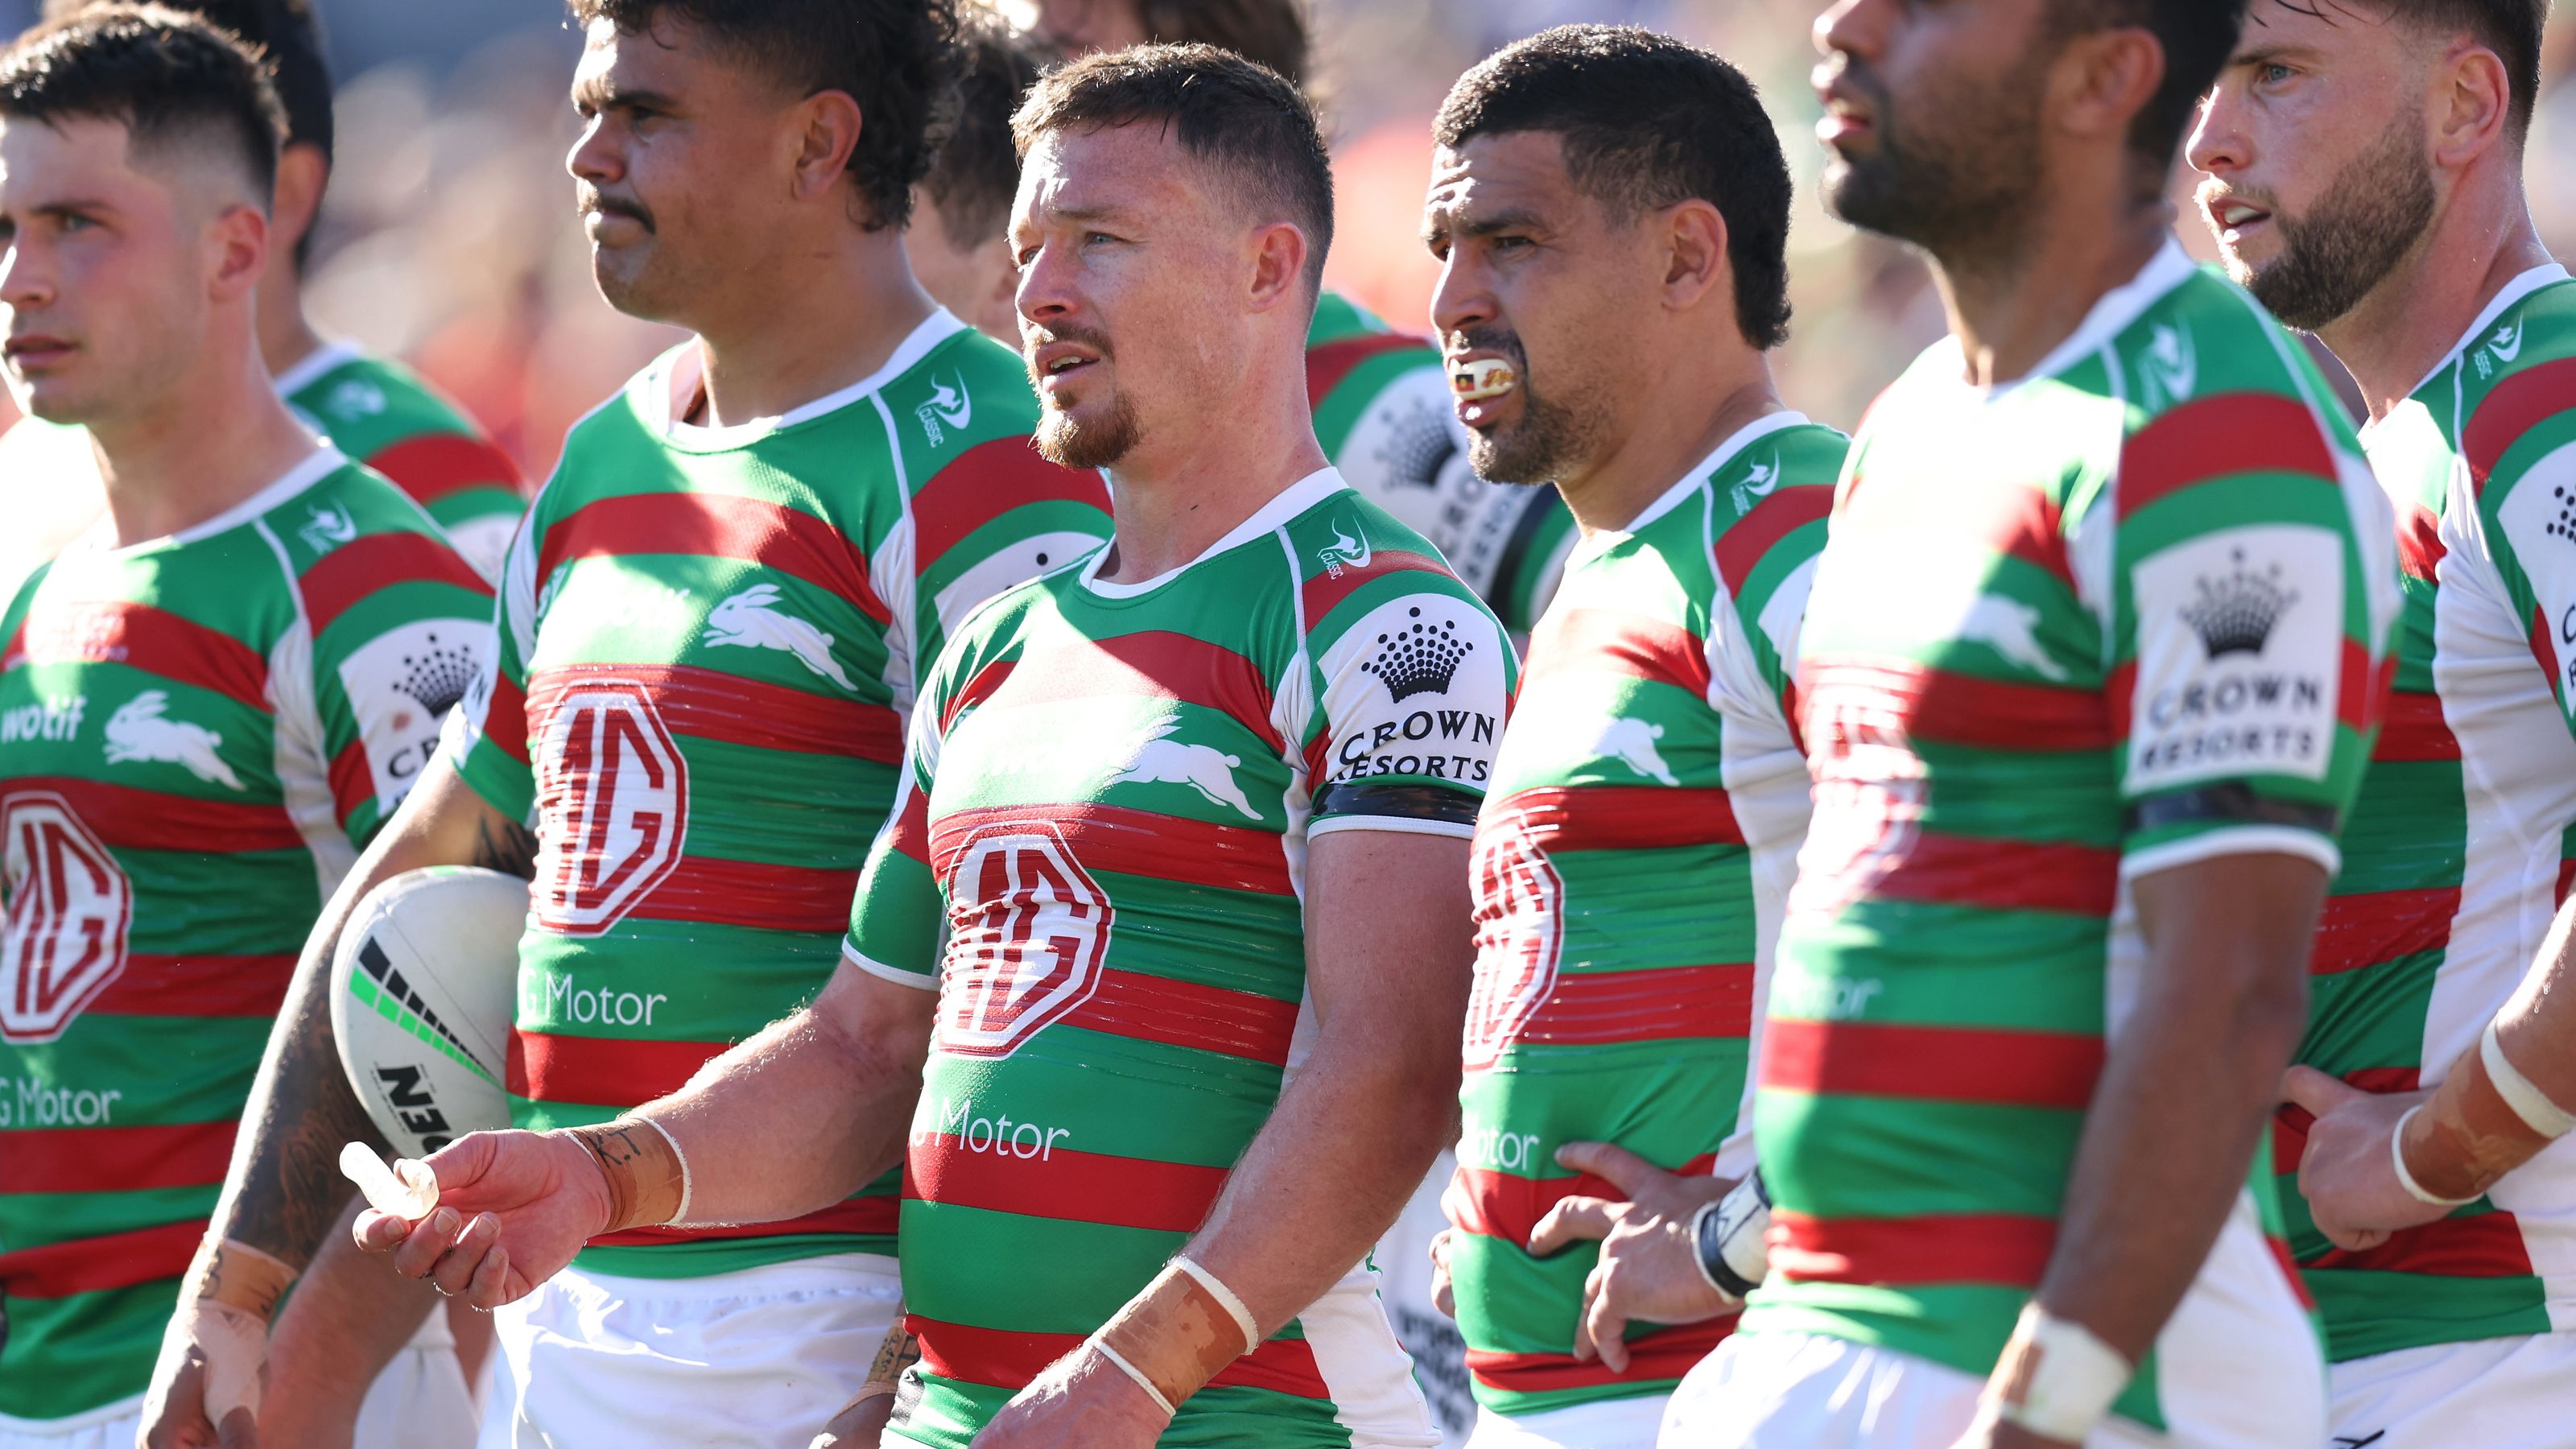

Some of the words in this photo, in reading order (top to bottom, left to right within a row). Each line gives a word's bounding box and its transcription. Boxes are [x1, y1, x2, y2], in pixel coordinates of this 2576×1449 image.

[1320, 552, 1344, 580] CLASSIC
[2, 695, 87, 743] wotif
[2149, 673, 2321, 729] CROWN
[1340, 710, 1496, 766] CROWN
[545, 971, 667, 1026] Motor
[16, 1076, 122, 1125] Motor
[935, 1096, 1071, 1162] Motor
